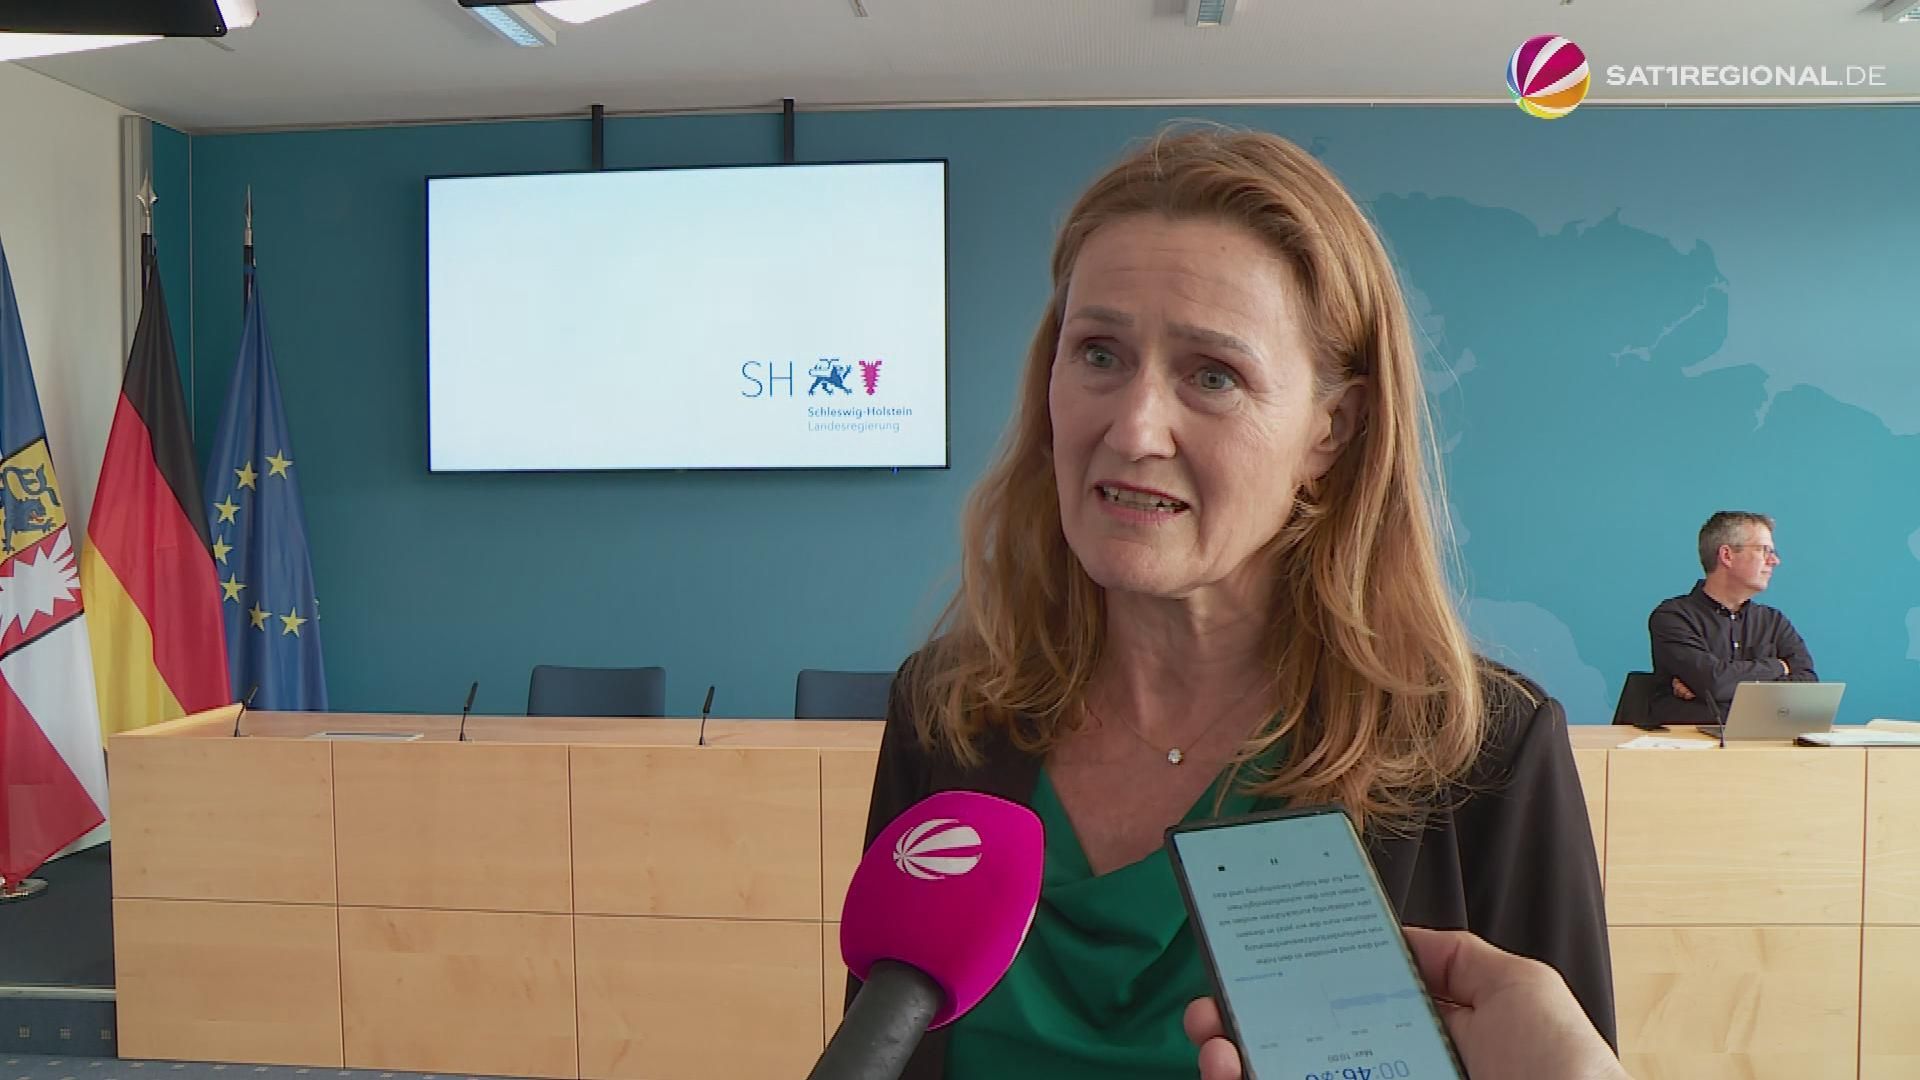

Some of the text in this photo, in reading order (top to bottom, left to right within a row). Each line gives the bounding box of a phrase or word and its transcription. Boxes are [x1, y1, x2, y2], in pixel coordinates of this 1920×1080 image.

[742, 361, 793, 398] SH
[807, 406, 913, 418] Schleswig-Holstein
[807, 420, 901, 433] Landesregierung
